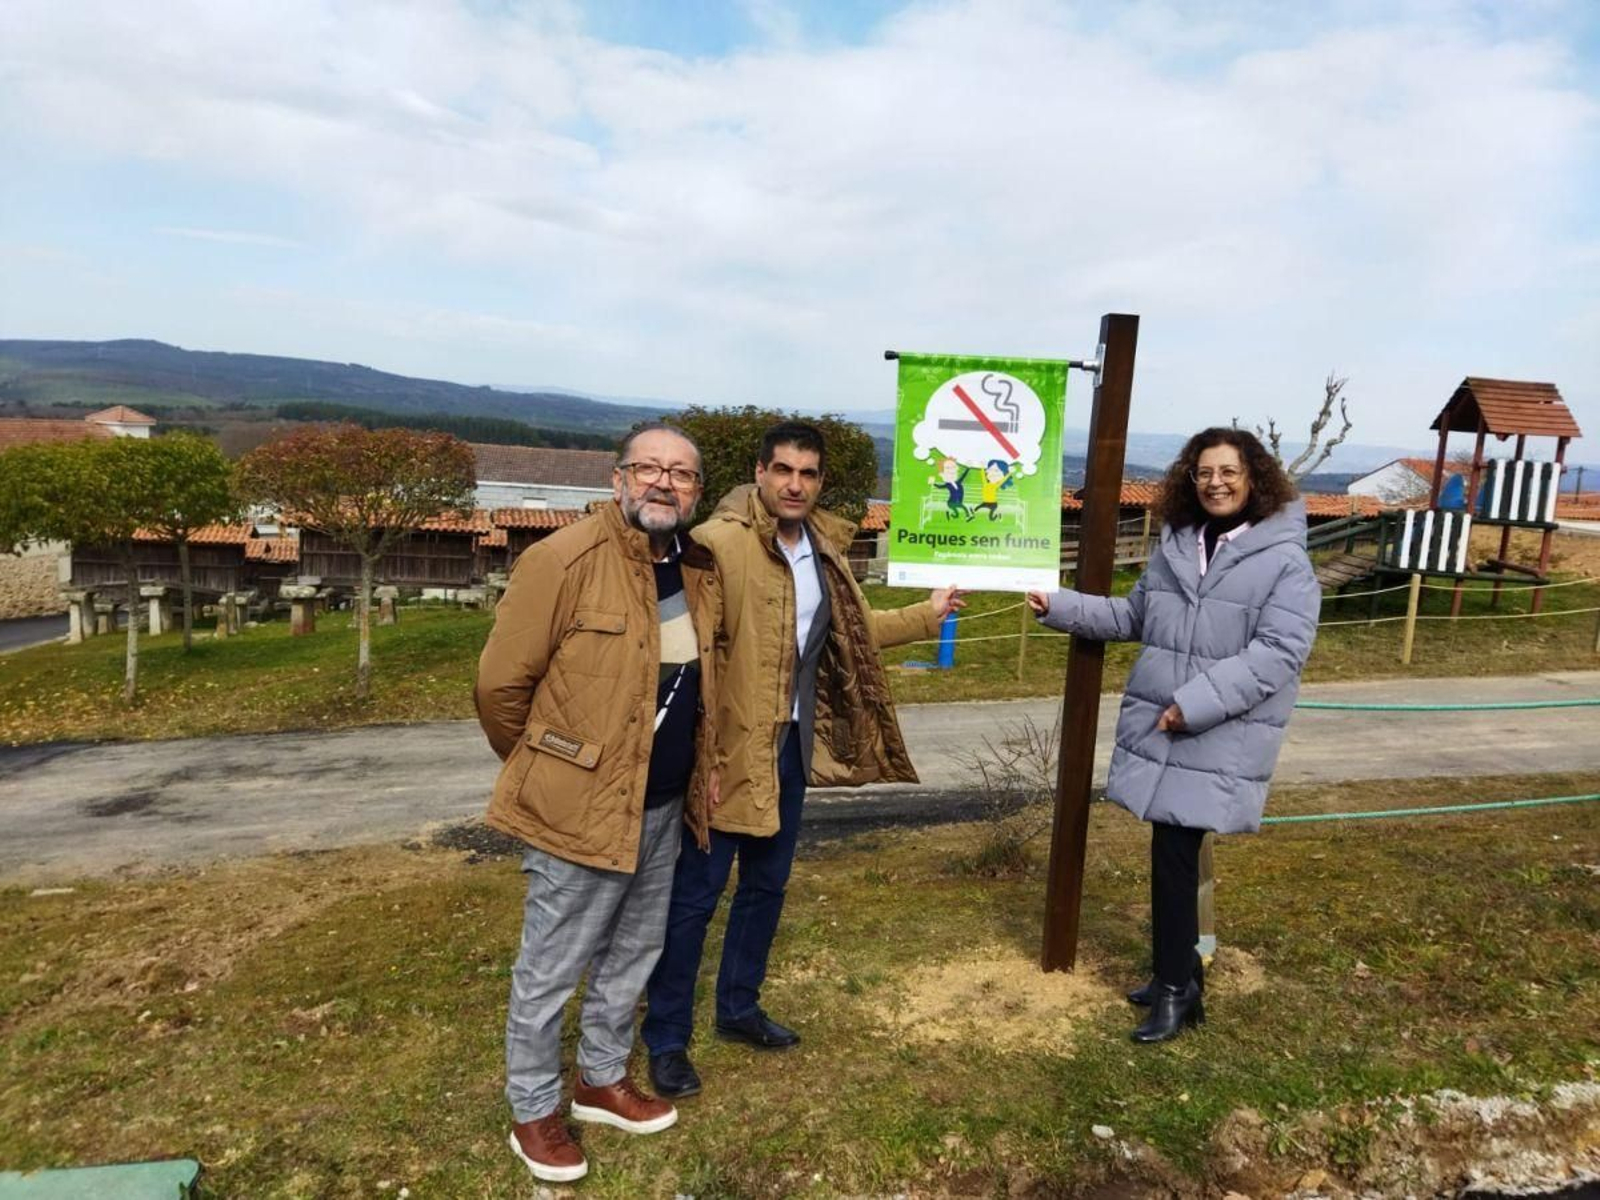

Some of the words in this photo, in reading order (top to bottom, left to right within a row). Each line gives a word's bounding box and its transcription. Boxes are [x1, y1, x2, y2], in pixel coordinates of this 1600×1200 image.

[897, 529, 966, 548] Parques
[970, 535, 1000, 547] sen
[1004, 533, 1050, 549] fume
